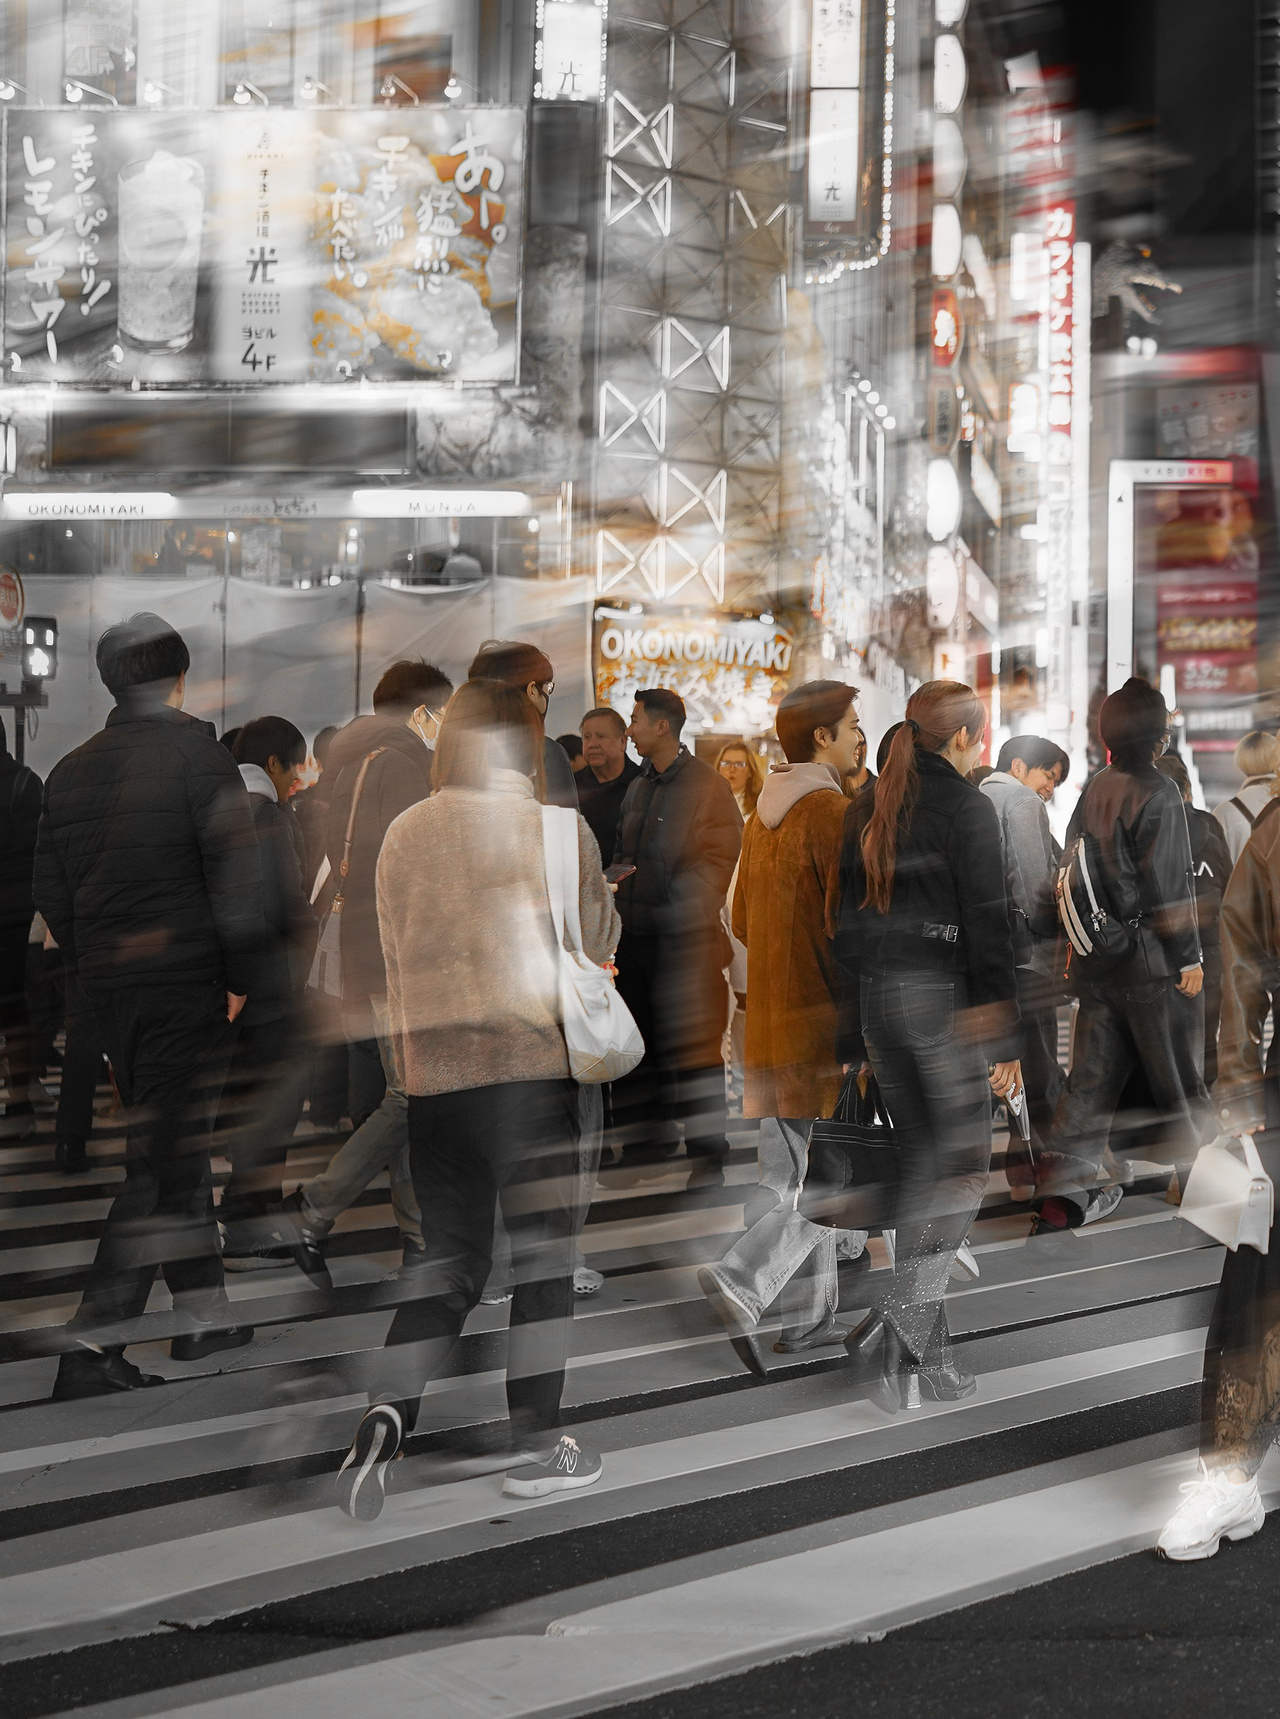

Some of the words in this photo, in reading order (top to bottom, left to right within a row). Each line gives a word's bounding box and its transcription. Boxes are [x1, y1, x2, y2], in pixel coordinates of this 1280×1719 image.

[22, 135, 66, 364] レモンサワー
[246, 246, 278, 284] 光
[241, 342, 277, 373] 4F
[28, 504, 145, 516] OKONOMIYAKI
[600, 627, 793, 672] OKONOMIYAKI
[556, 1447, 578, 1474] N
